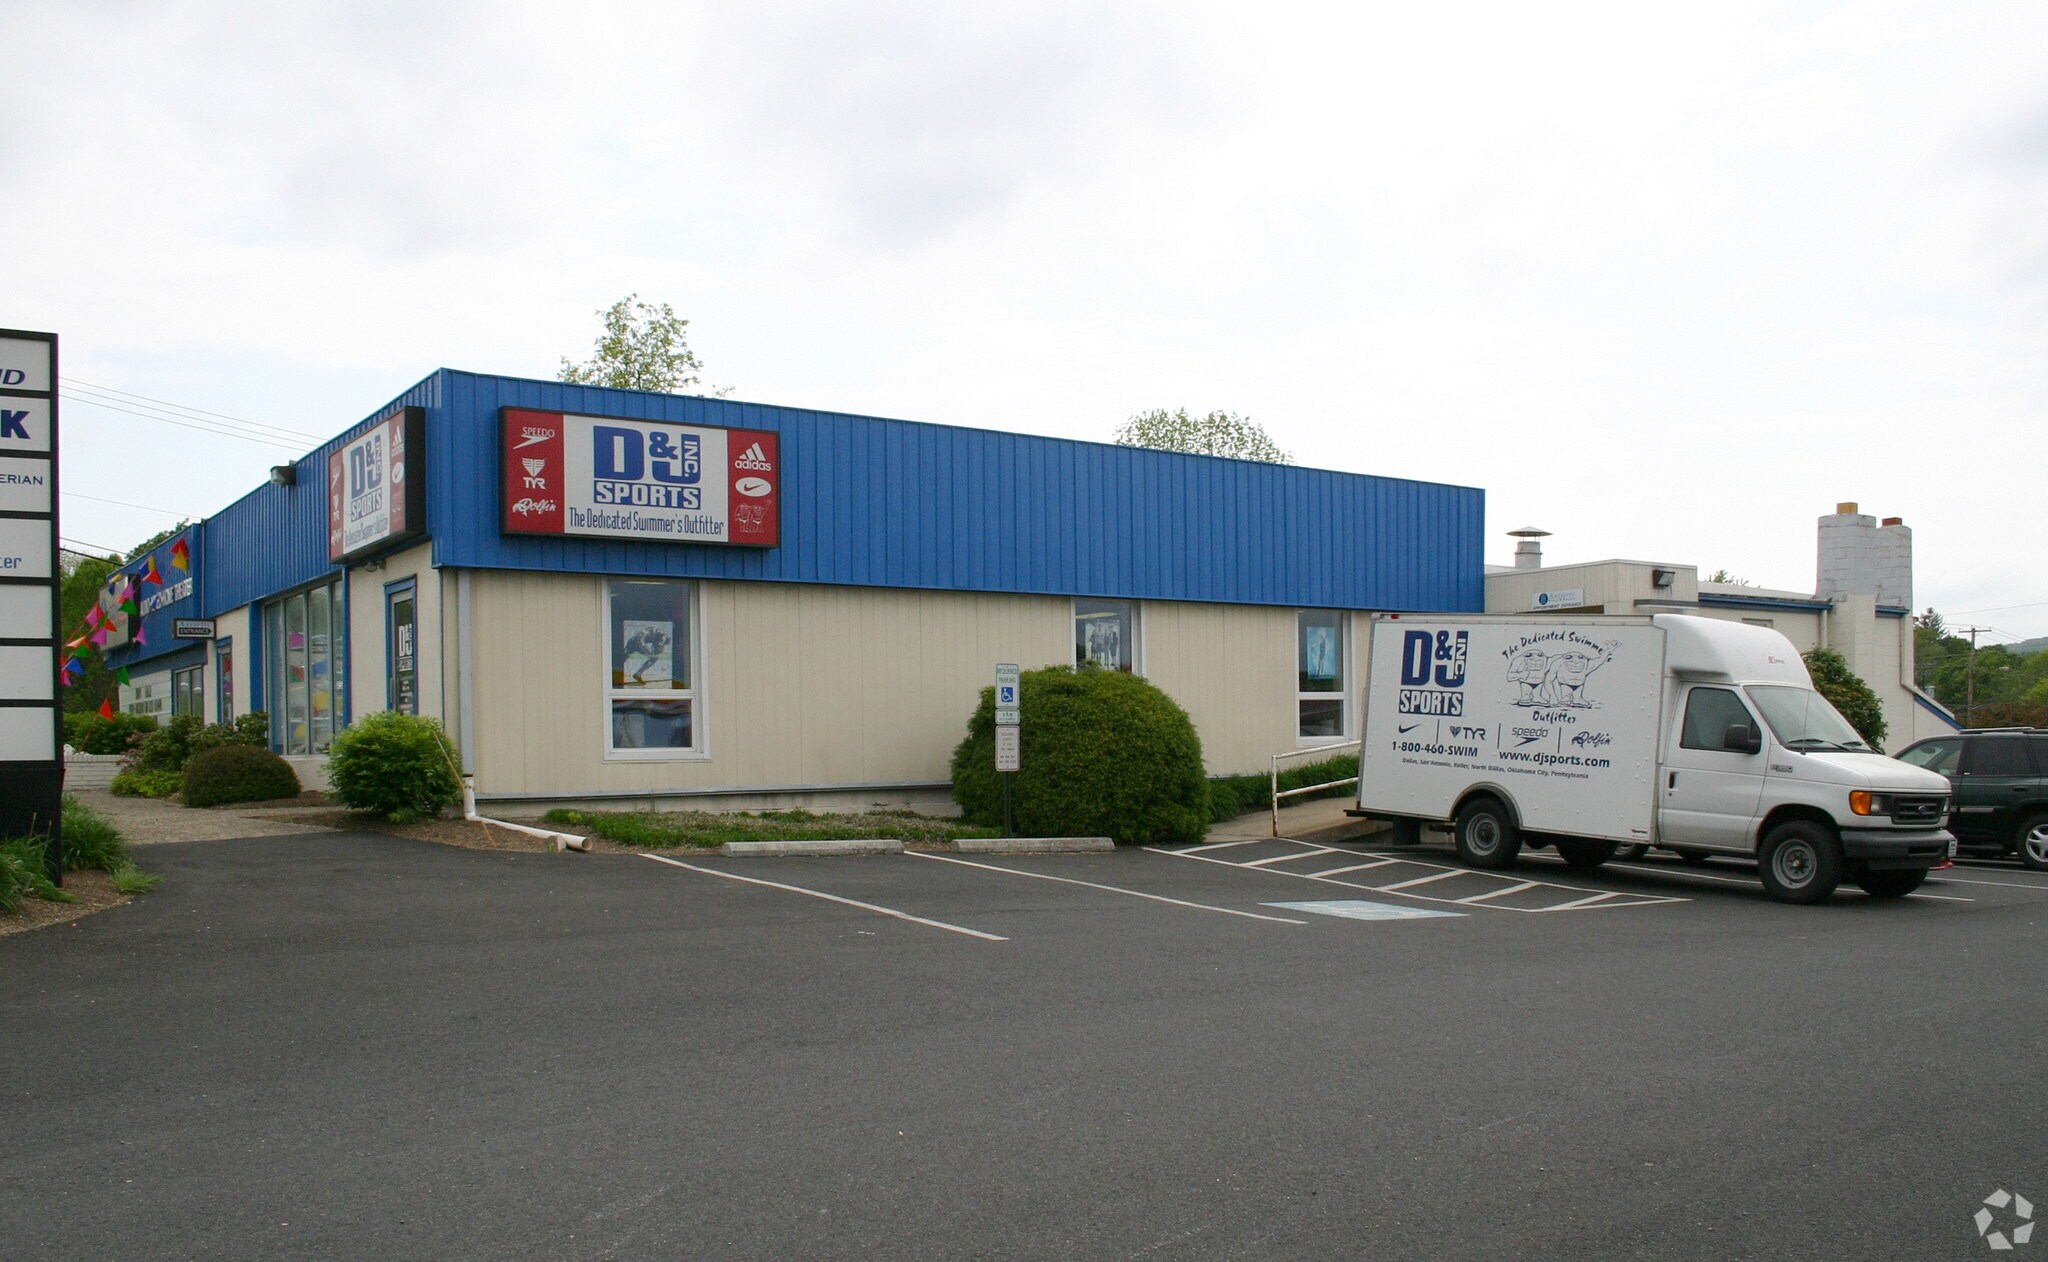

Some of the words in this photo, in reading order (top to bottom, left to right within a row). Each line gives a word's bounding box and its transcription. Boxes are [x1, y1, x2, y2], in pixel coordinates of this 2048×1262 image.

[522, 426, 555, 438] SPEEDO
[735, 459, 772, 472] adidas
[523, 477, 546, 490] TYR
[596, 481, 700, 510] SPORTS
[351, 489, 382, 520] SPORTS
[513, 498, 557, 516] Dolfin
[569, 507, 585, 528] The
[587, 508, 632, 530] Dedicated
[684, 514, 724, 535] Outfitter
[1502, 643, 1518, 660] The
[1520, 630, 1567, 647] Dedicated
[1399, 690, 1463, 716] SPORTS
[1532, 710, 1576, 725] Outfitter
[1463, 727, 1486, 740] TYR
[1512, 726, 1549, 738] speedo
[1572, 731, 1612, 749] Dolfin
[1392, 741, 1478, 757] 1-800-460-SWIM
[1499, 751, 1610, 768] www.djsports.com
[1507, 766, 1536, 775] Oklahoma
[1550, 770, 1589, 779] Pennsylvania
